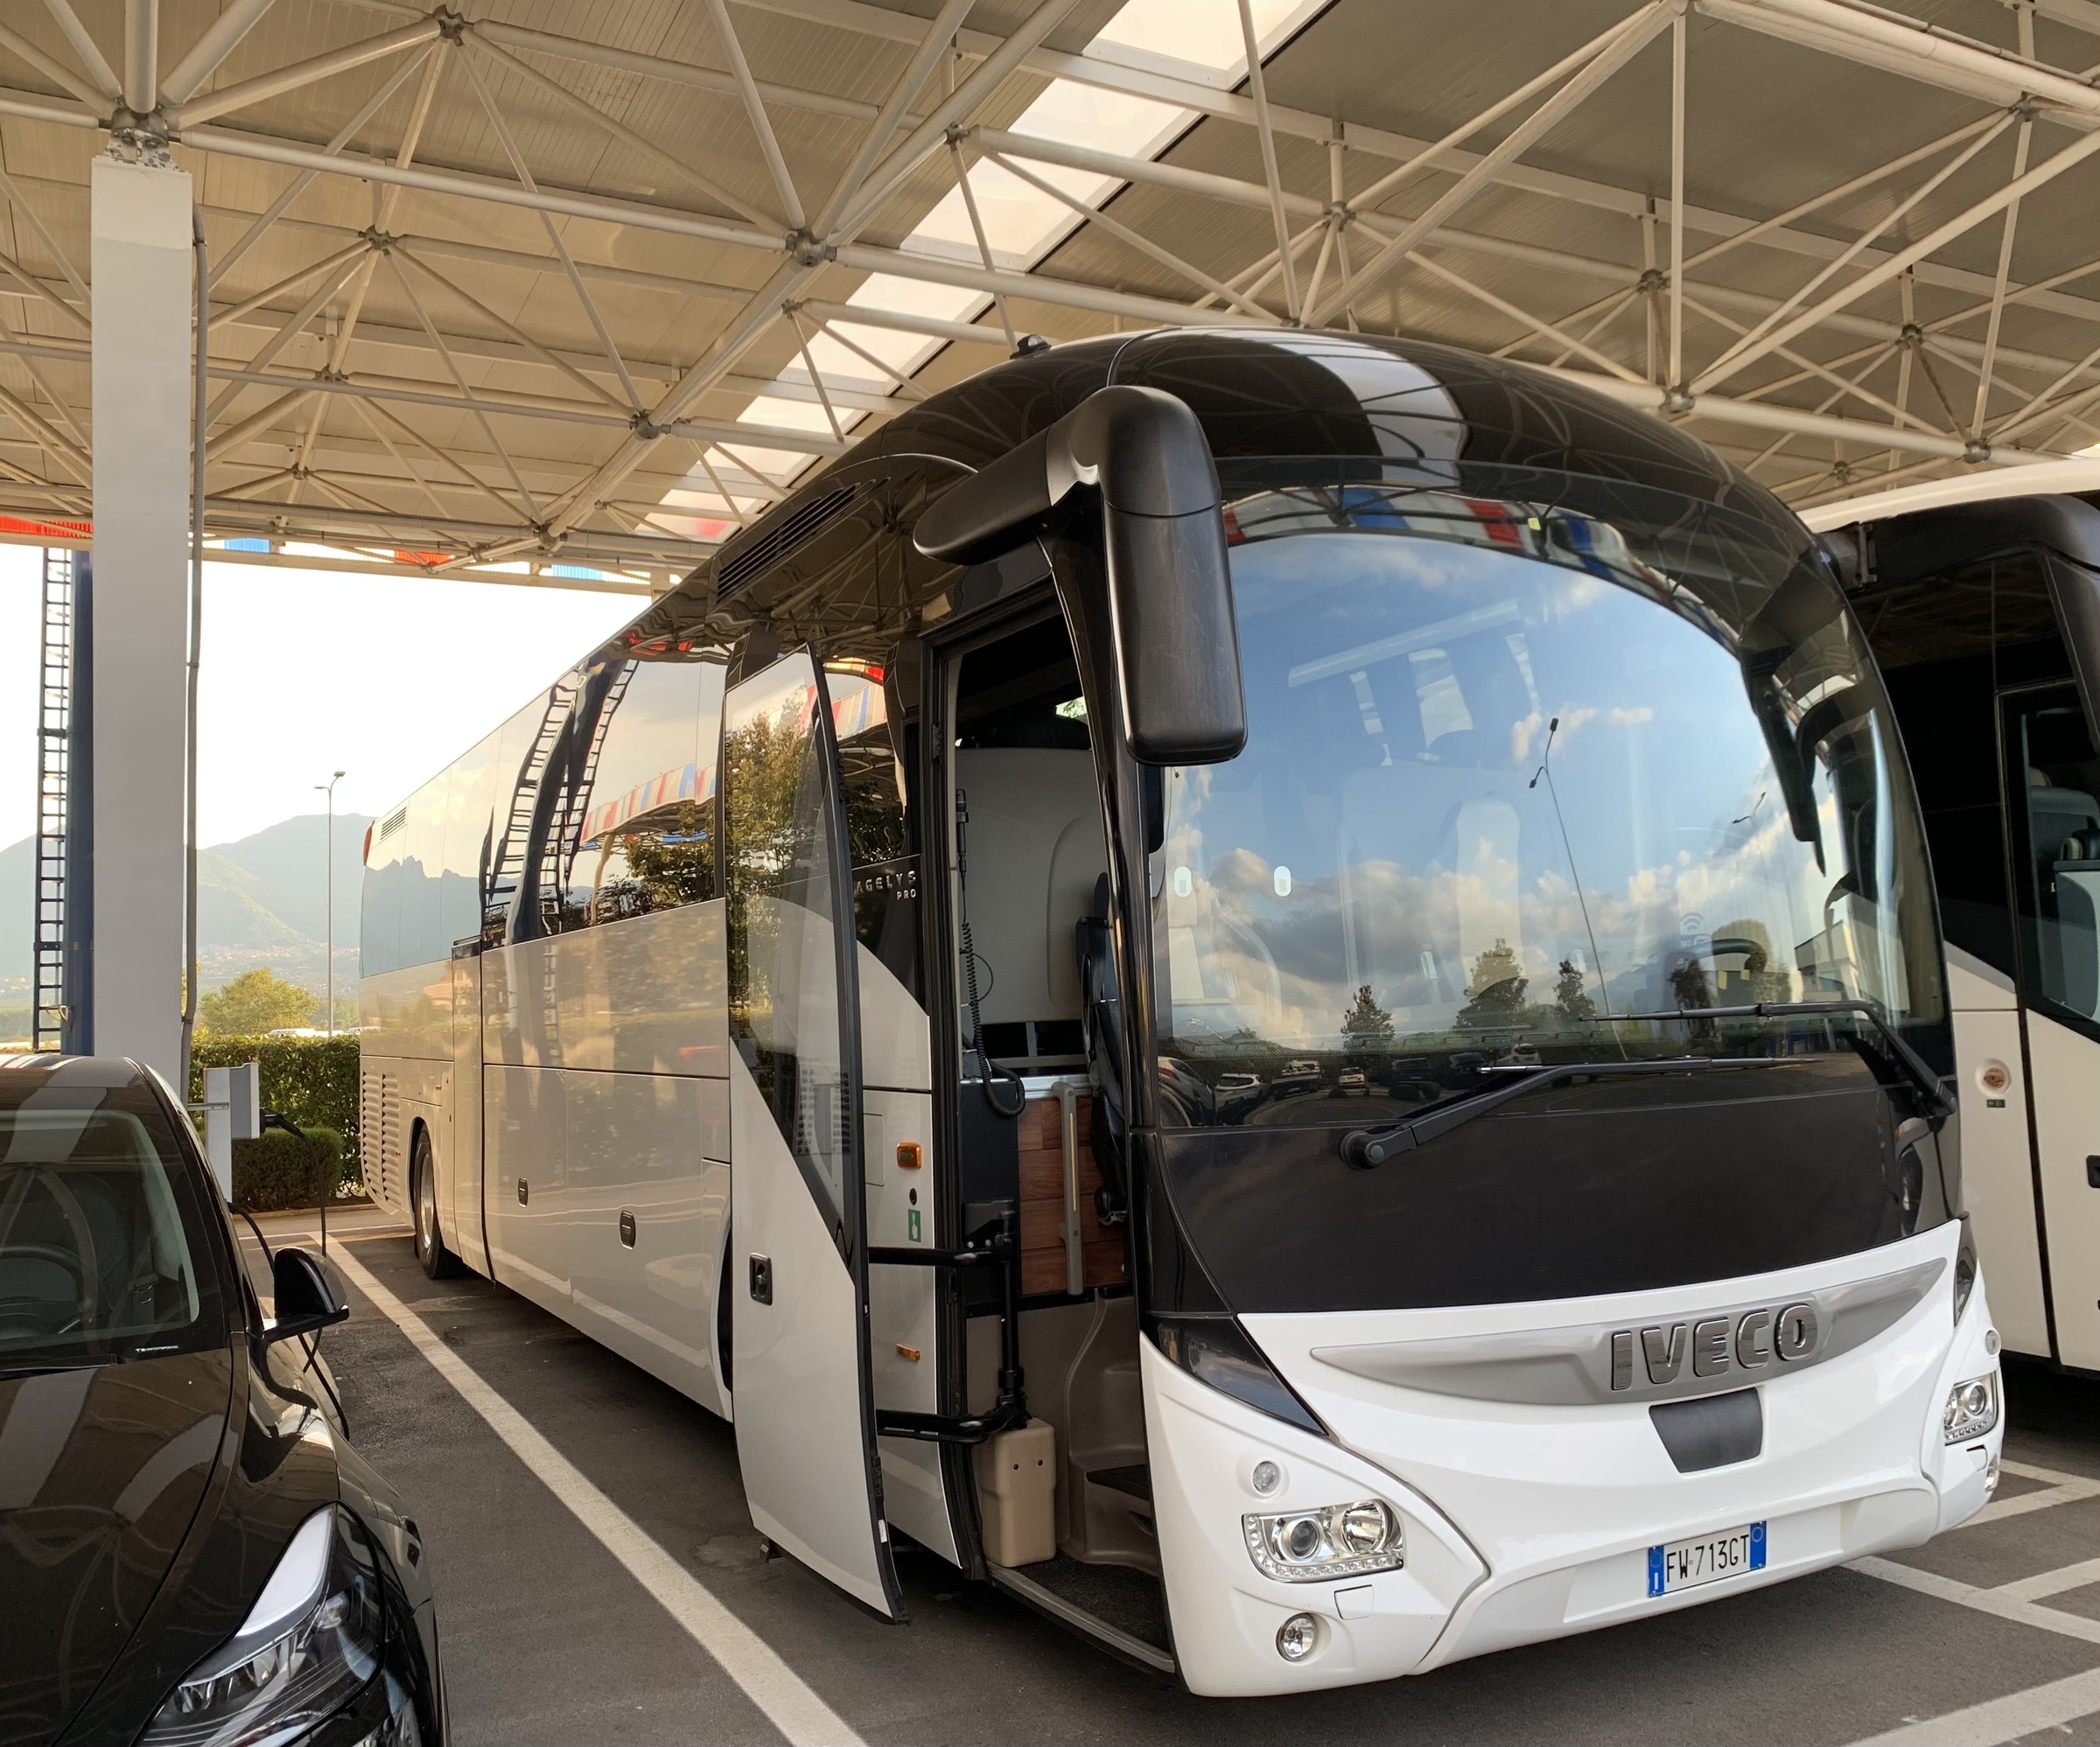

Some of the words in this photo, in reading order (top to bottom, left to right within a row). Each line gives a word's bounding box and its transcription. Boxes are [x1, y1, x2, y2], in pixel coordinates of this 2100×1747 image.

[857, 870, 916, 893] AGELYS
[896, 888, 916, 900] PRO
[1611, 1302, 1817, 1391] IVECO
